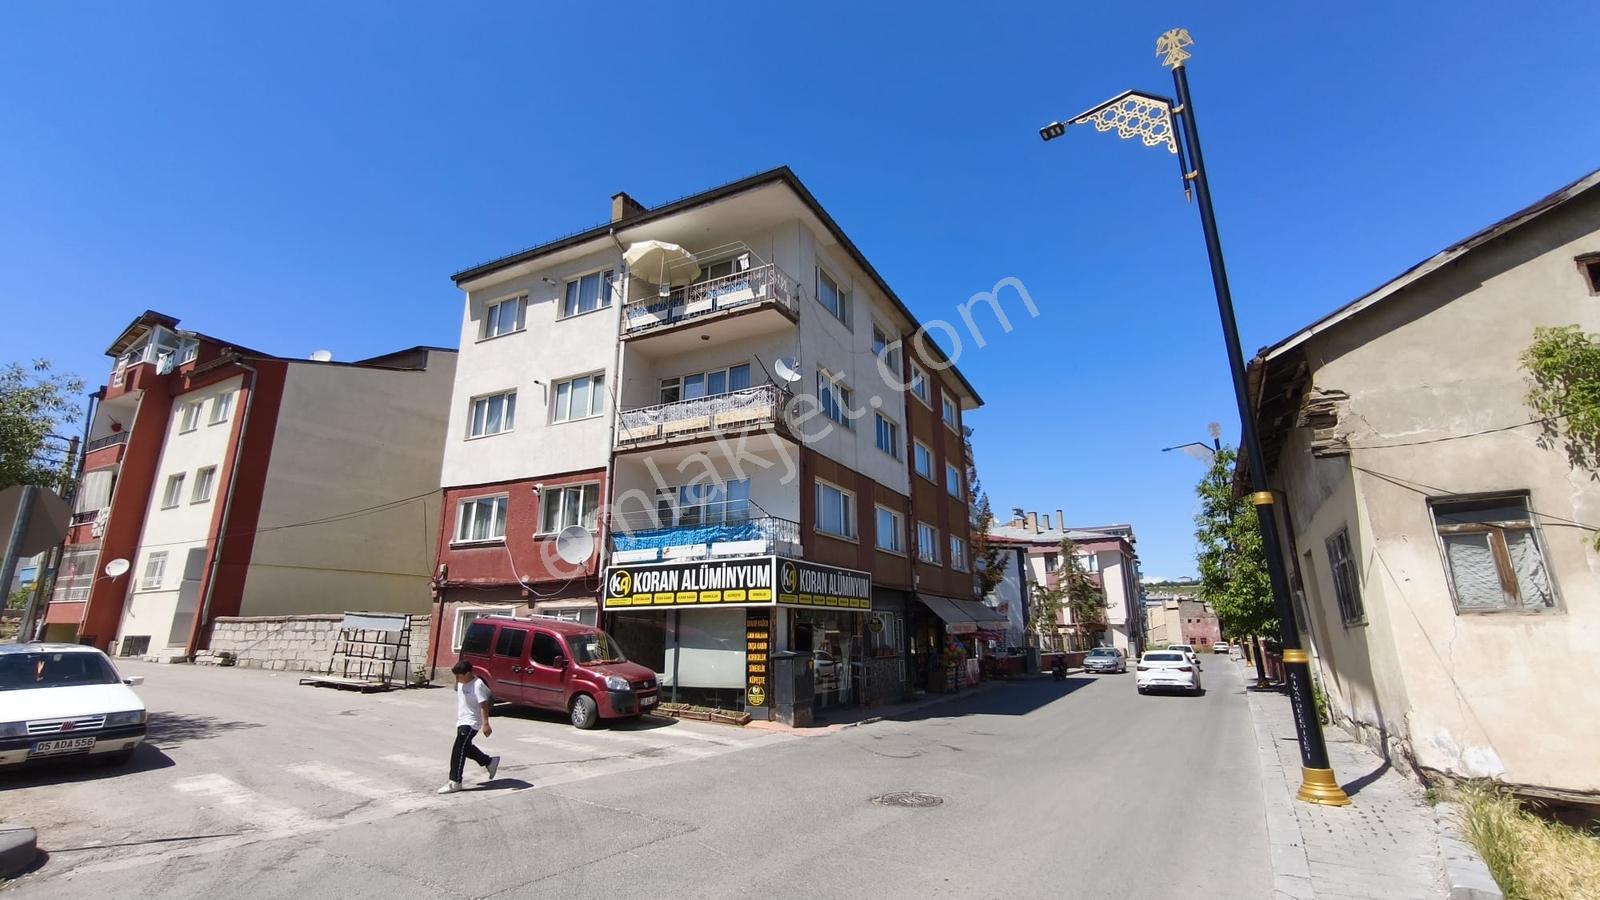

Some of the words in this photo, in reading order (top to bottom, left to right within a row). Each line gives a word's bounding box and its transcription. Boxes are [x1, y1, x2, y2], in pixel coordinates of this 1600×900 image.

[633, 570, 679, 593] KORAN
[681, 562, 770, 590] ALÜMİNYUM
[800, 569, 827, 594] KORAN
[829, 571, 869, 598] ALÜMİNYUM
[38, 742, 51, 751] 05
[53, 740, 73, 750] ADA
[75, 738, 94, 747] 556
